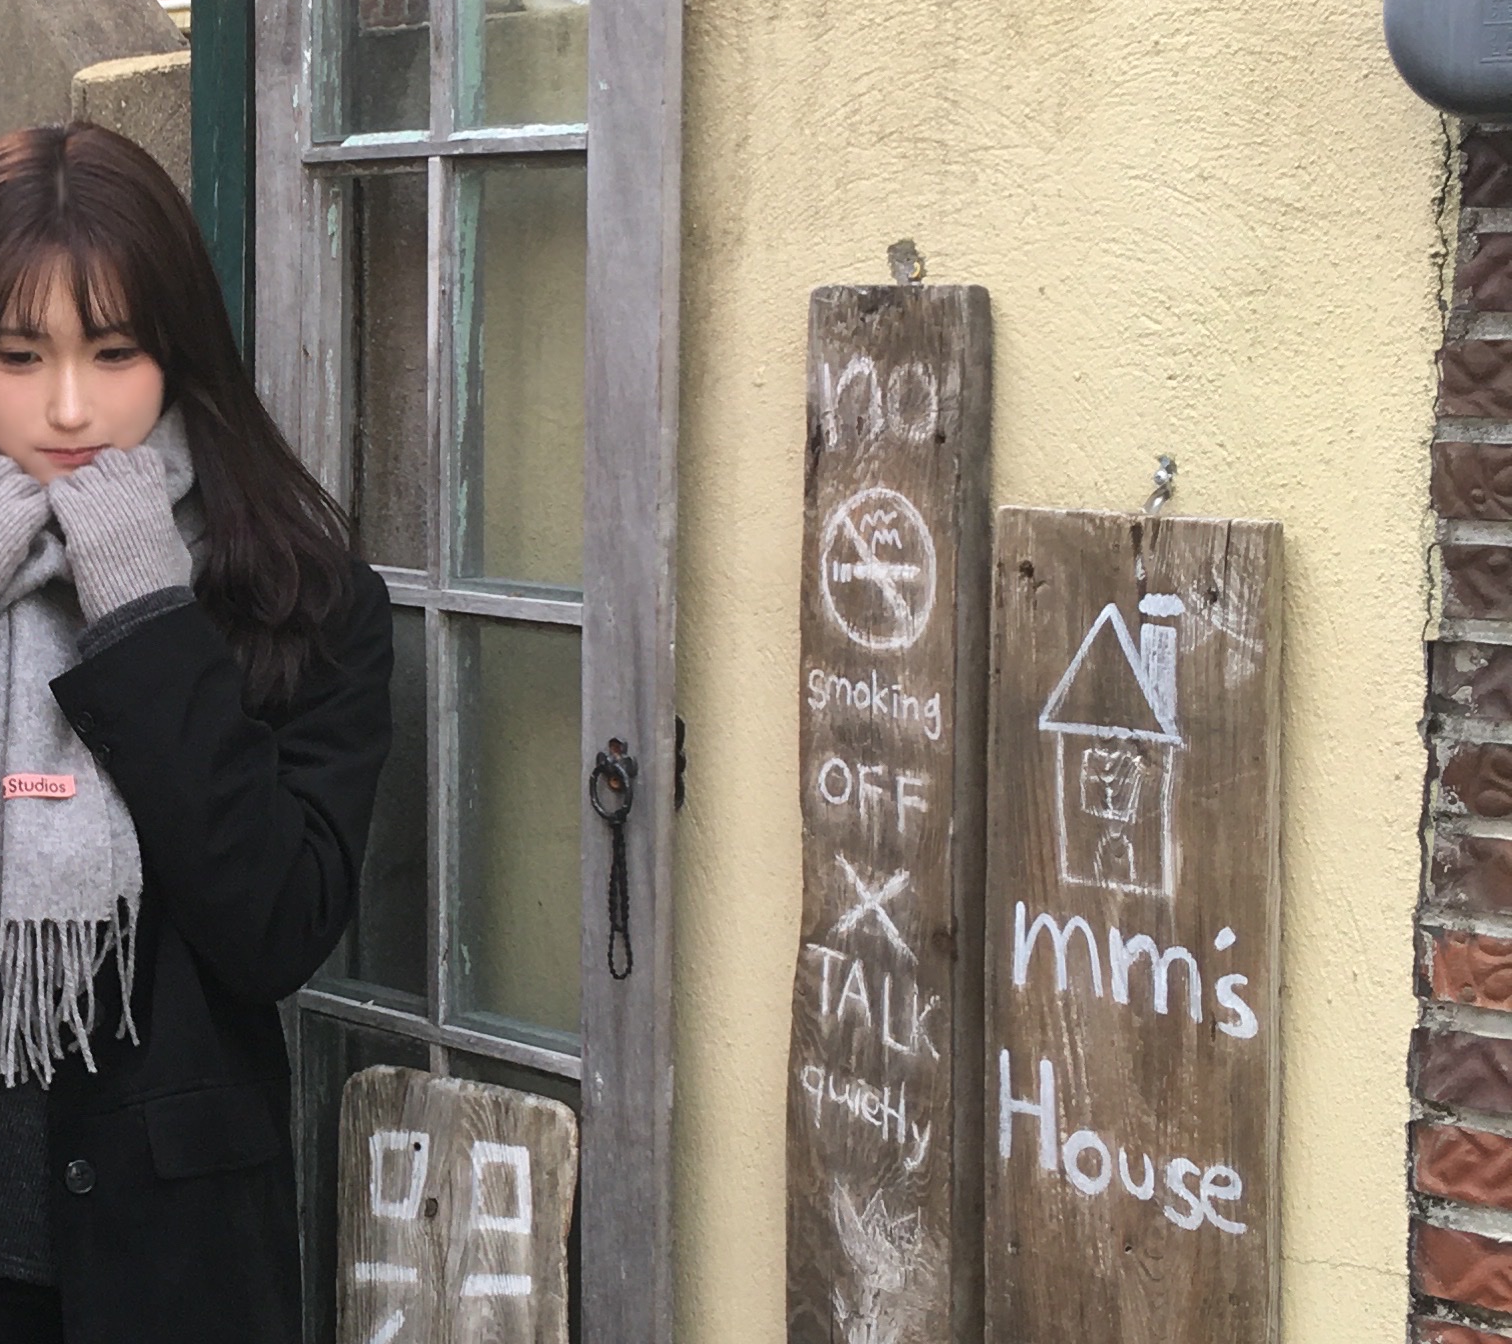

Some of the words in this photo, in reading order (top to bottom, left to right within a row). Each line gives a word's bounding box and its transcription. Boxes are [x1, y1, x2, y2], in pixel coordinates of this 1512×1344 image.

[819, 355, 938, 451] no
[8, 777, 66, 793] Studios
[818, 757, 930, 834] OFF
[999, 1048, 1248, 1235] House
